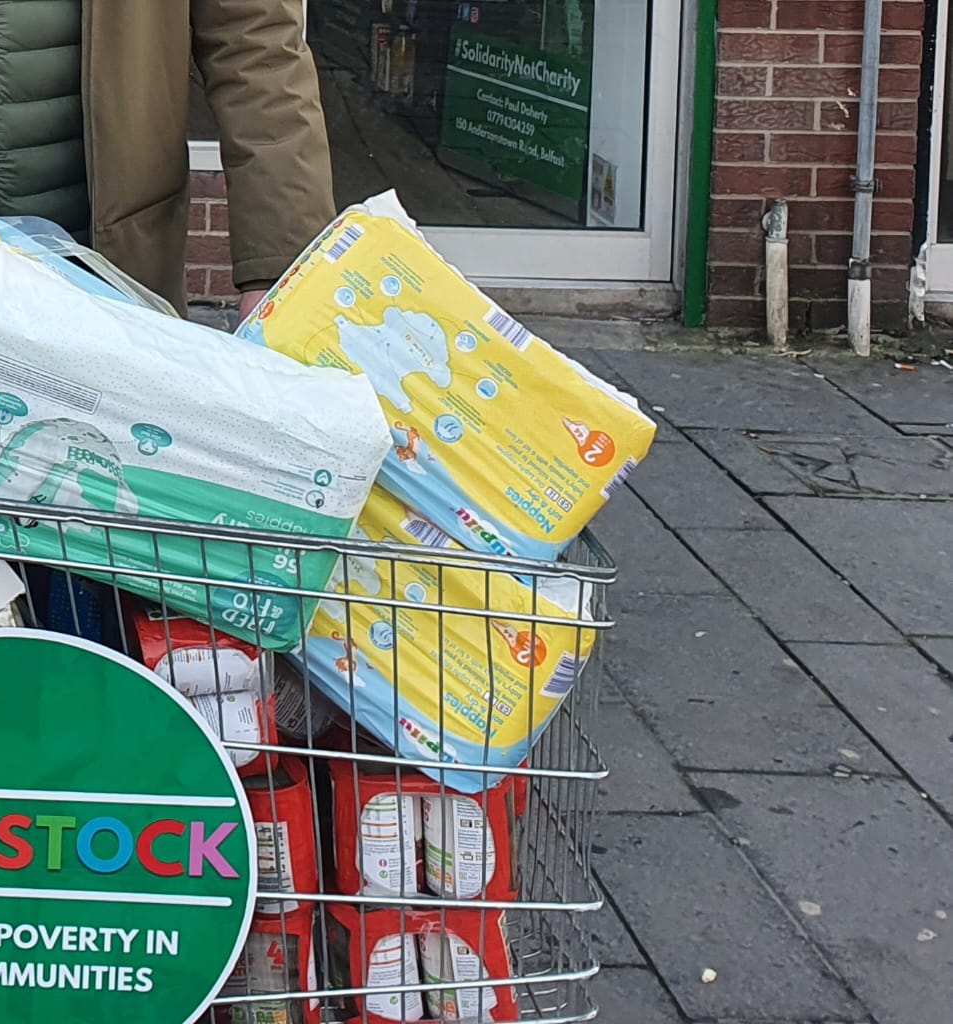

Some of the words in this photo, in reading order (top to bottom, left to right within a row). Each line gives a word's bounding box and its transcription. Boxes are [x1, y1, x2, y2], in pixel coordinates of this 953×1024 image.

[455, 38, 582, 97] #SolidarityNotCharity
[456, 117, 467, 131] 150
[505, 97, 520, 112] Paul
[520, 102, 548, 125] Doherty
[583, 445, 603, 463] 2
[246, 509, 314, 535] appies
[505, 485, 556, 534] Nappies
[547, 506, 564, 522] soft
[455, 506, 513, 557] upilu
[146, 930, 179, 955] IN
